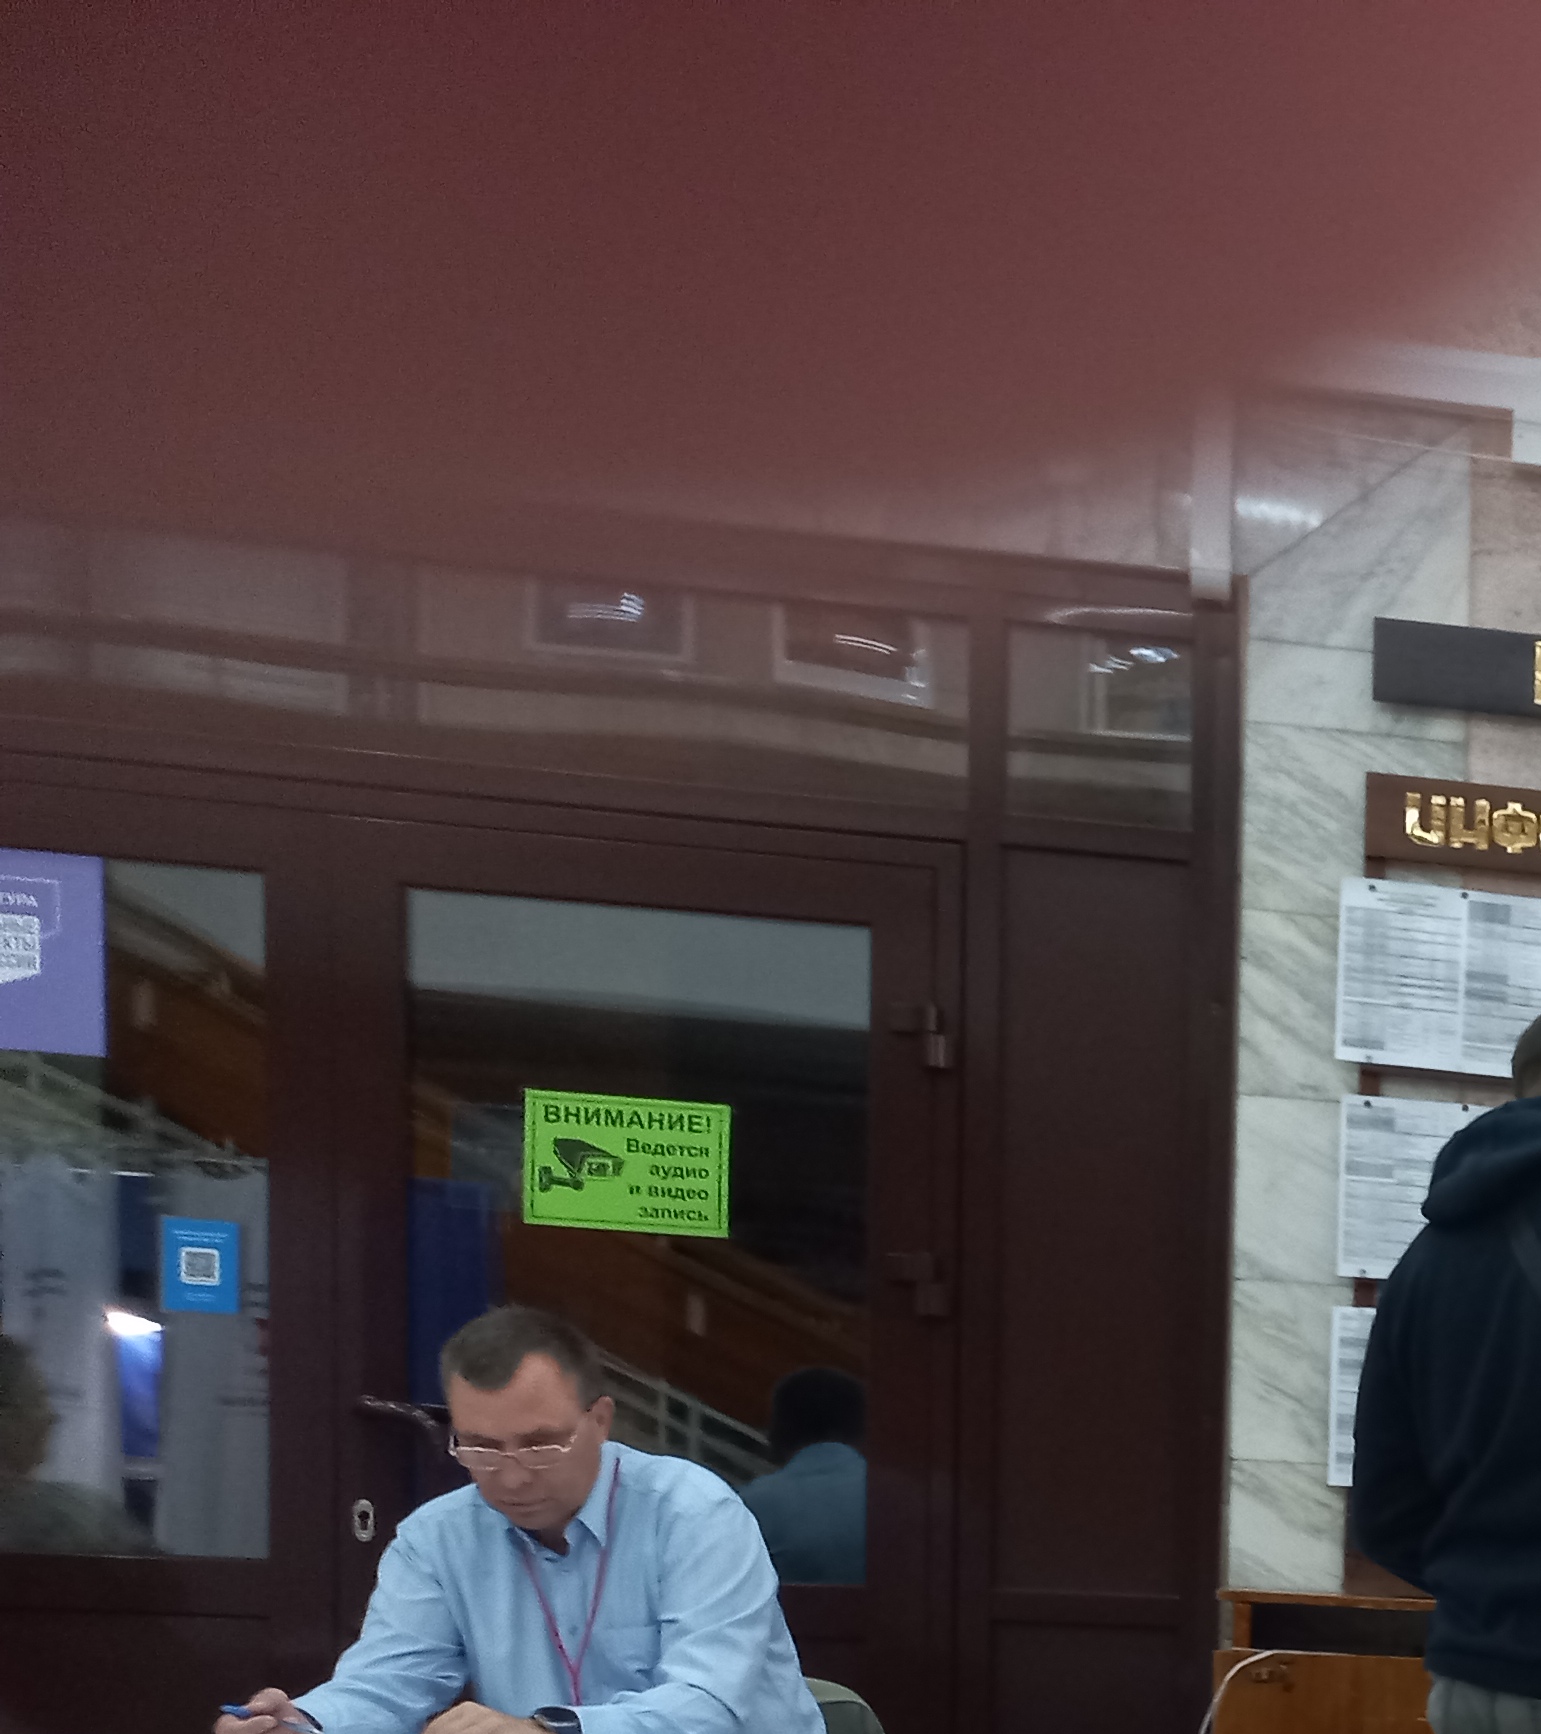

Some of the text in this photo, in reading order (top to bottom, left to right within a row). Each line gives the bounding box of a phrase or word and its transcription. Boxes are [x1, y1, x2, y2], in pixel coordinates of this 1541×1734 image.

[543, 1103, 712, 1134] ВНИМАНИЕ!
[649, 1164, 710, 1180] аудио
[648, 1184, 709, 1201] видео
[638, 1205, 709, 1222] запись
